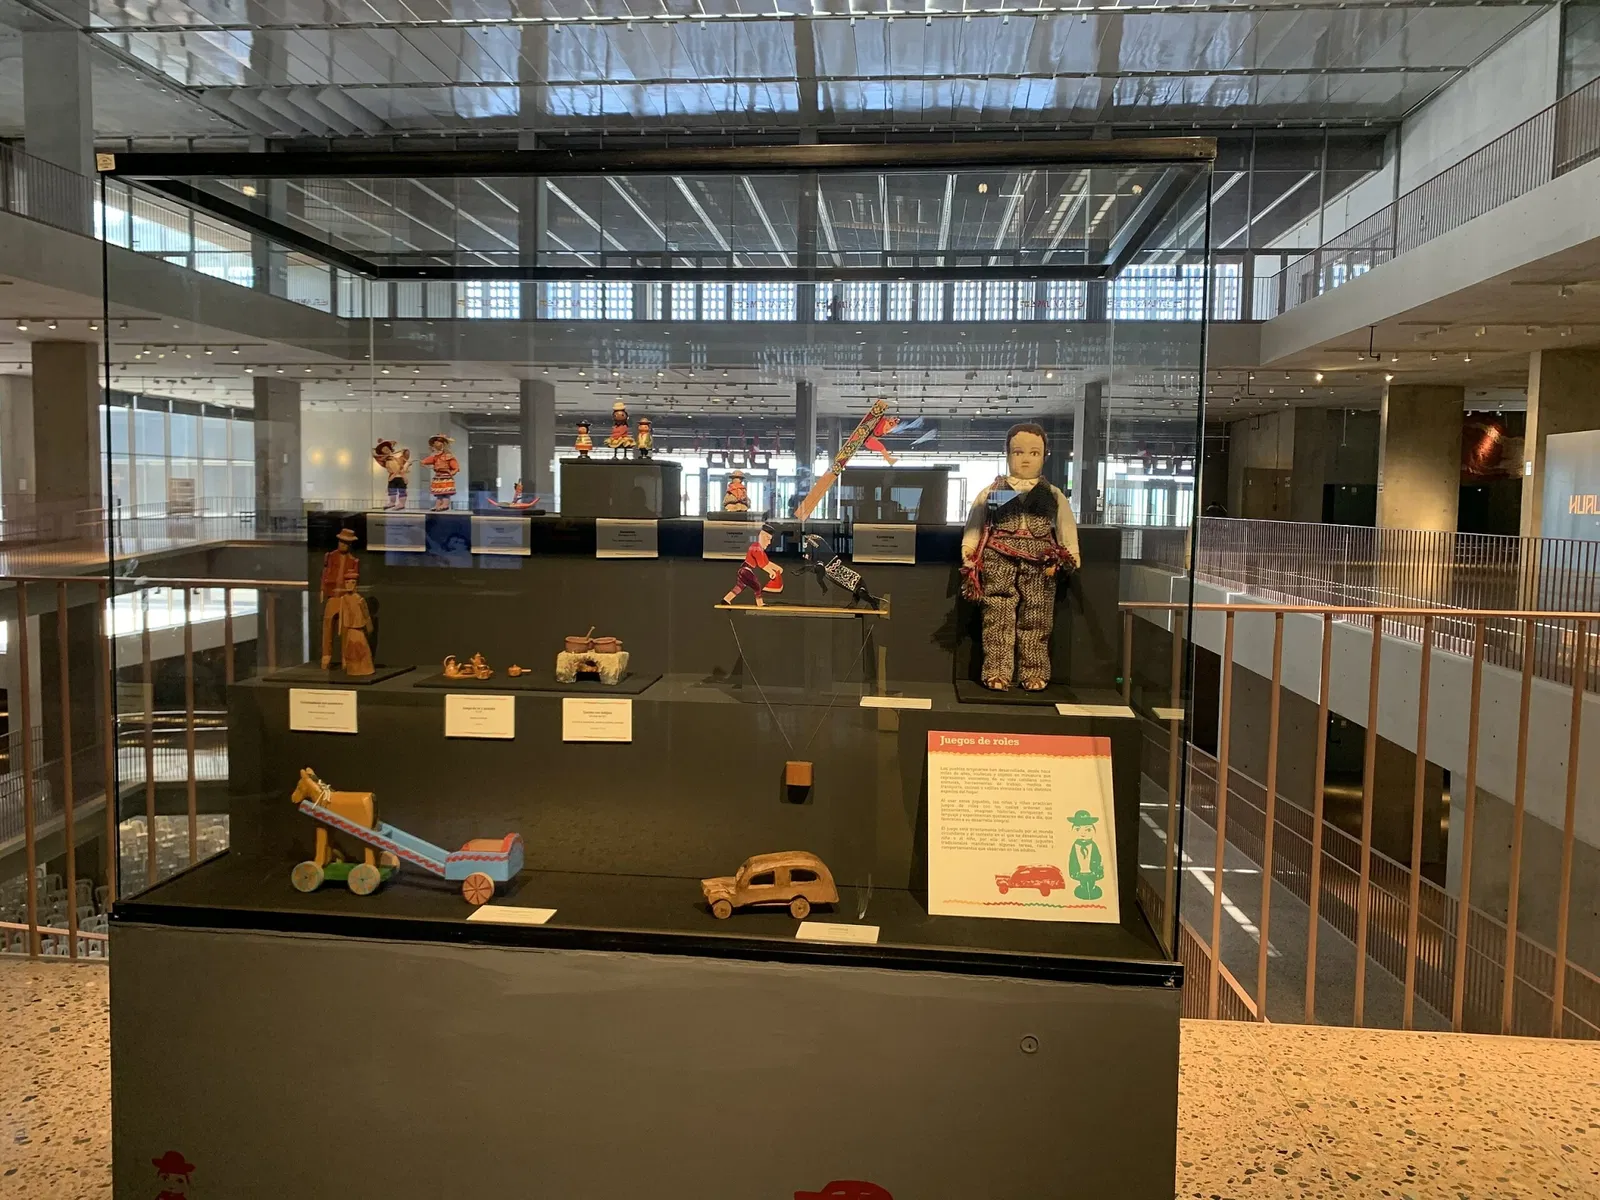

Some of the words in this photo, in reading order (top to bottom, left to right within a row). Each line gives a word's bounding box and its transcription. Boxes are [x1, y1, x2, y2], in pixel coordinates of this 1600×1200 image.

[940, 735, 975, 747] Juegos
[978, 736, 991, 746] de
[993, 737, 1020, 746] roles
